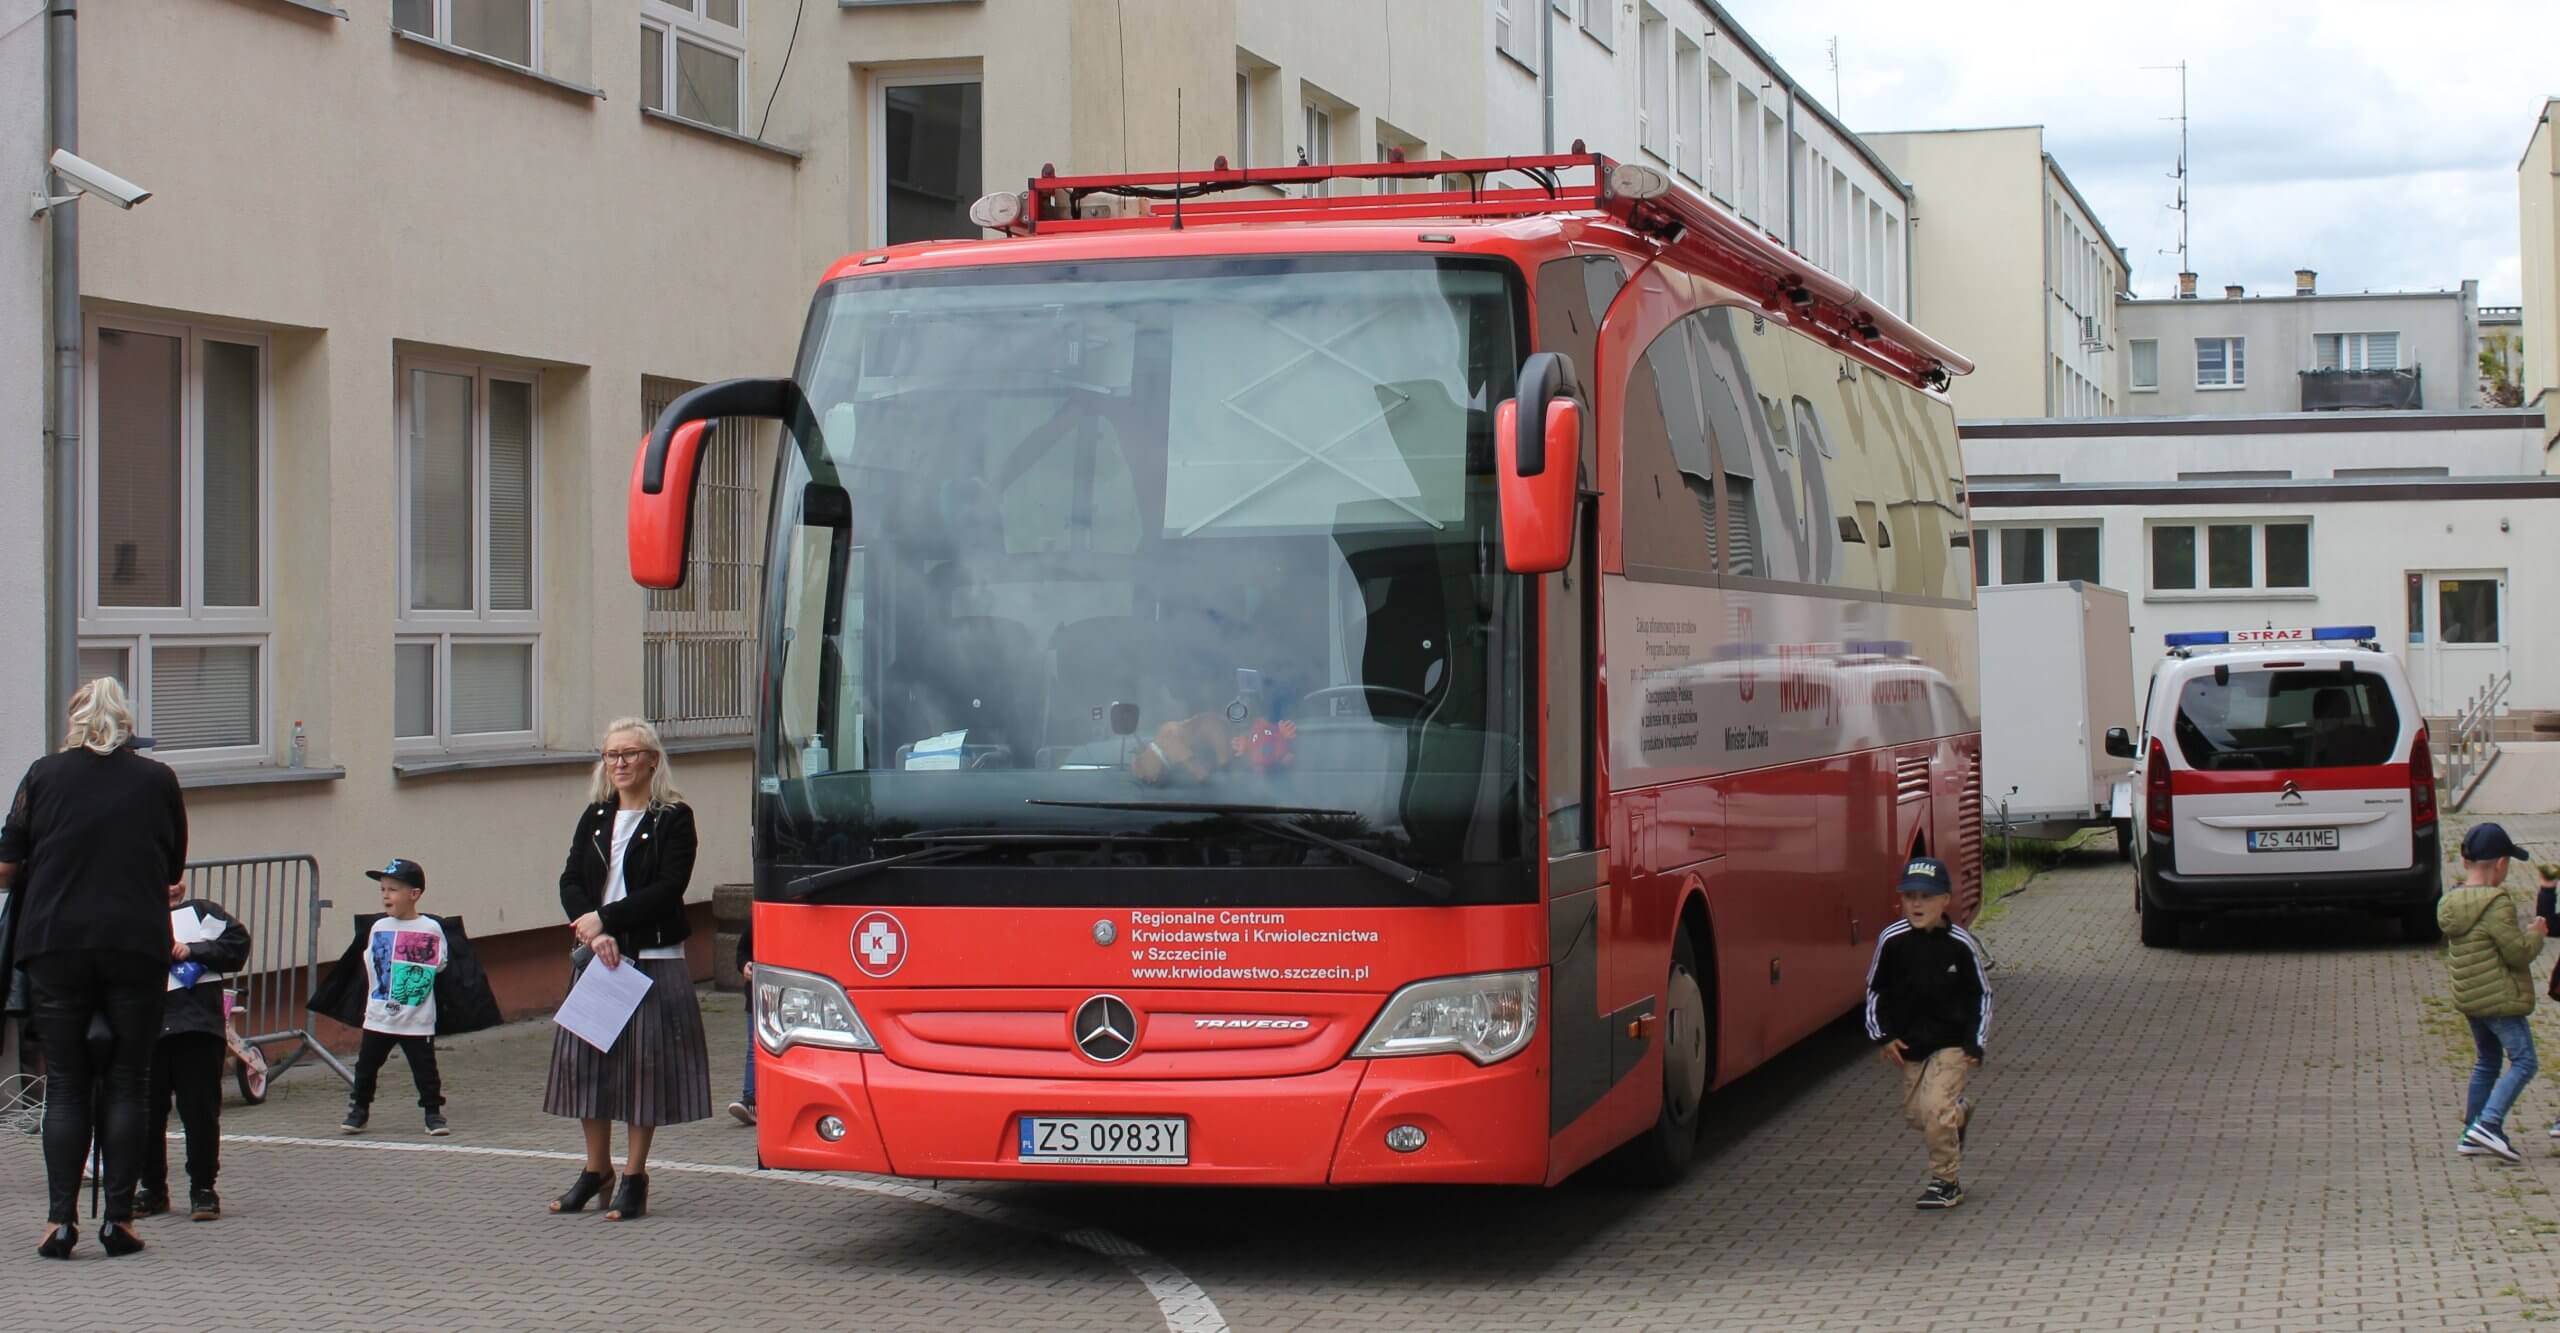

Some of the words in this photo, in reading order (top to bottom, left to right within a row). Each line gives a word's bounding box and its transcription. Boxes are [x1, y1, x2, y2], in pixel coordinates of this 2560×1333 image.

[1724, 726, 1747, 752] Minister
[1747, 724, 1769, 749] Zdrowia
[2258, 831, 2280, 848] ZS
[2285, 830, 2334, 847] 441ME
[1131, 911, 1215, 927] Regionalne
[1219, 911, 1285, 925] Centrum
[872, 936, 883, 950] K
[1131, 929, 1240, 943] Krwiodawstwa
[1244, 929, 1249, 943] i
[1253, 929, 1379, 943] Krwiolecznictwa
[1131, 950, 1143, 961] w
[1147, 947, 1227, 961] Szczecinie
[1131, 965, 1370, 982] www.krwiodawstwo.szczecin.pl
[1194, 1019, 1309, 1030] TRAVEGO
[1038, 1122, 1079, 1152] ZS
[1090, 1123, 1179, 1153] 0983Y
